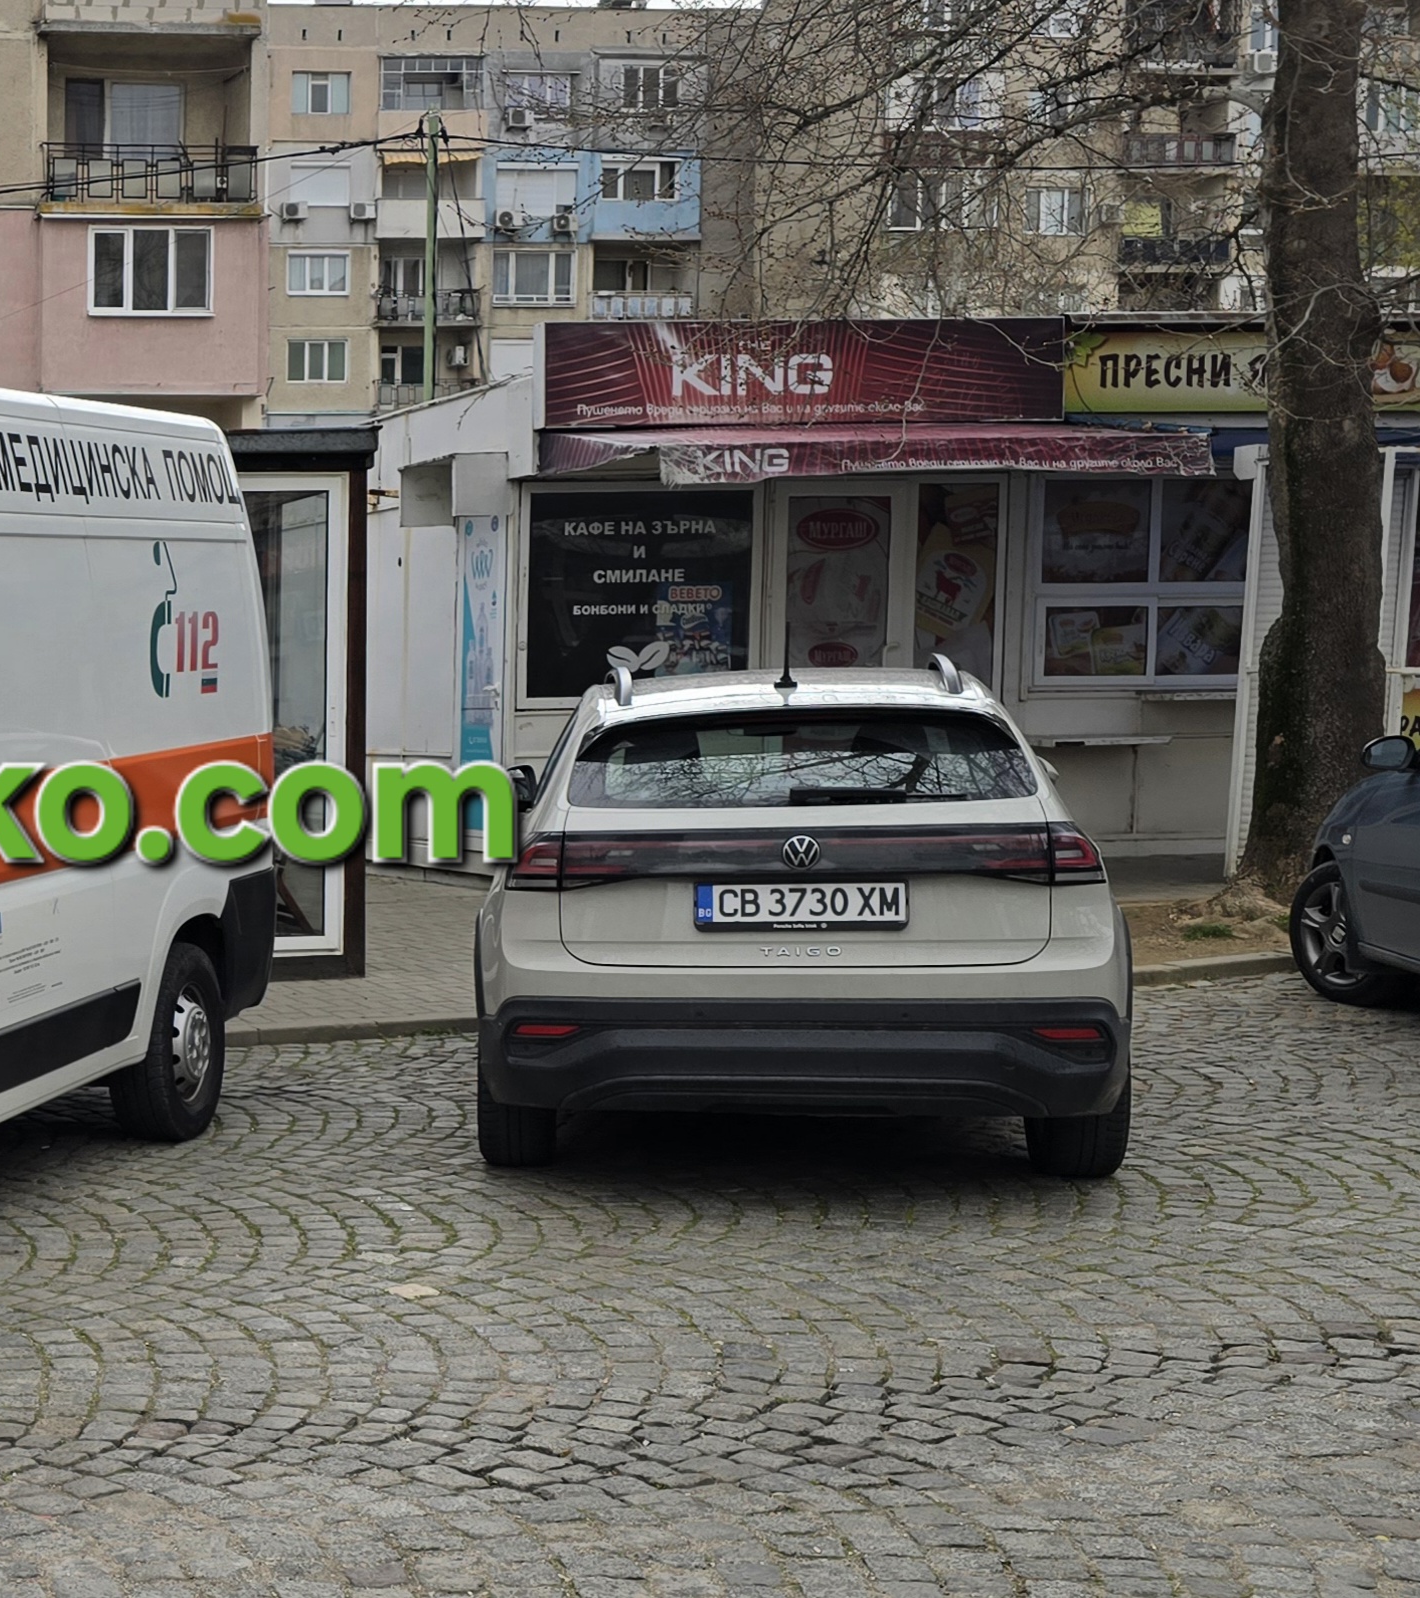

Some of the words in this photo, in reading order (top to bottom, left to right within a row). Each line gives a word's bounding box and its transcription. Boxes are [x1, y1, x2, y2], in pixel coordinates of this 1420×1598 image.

[672, 353, 834, 396] KING
[1098, 353, 1232, 389] ПРЕСНИ
[577, 404, 643, 417] Пушенето
[761, 402, 785, 415] Вас
[697, 448, 790, 474] KING
[1019, 457, 1041, 468] Вас
[1053, 460, 1067, 469] на
[1070, 459, 1119, 471] другите
[1156, 456, 1179, 468] Вас
[564, 521, 615, 536] КАФЕ
[621, 521, 646, 535] НА
[651, 520, 717, 535] ЗЪРНА
[808, 520, 869, 539] МУРГАШ
[633, 545, 646, 559] И
[593, 568, 685, 584] СМИЛАНЕ
[572, 604, 636, 616] БОНБОНИ
[640, 604, 649, 615] И
[175, 611, 220, 673] 112
[718, 888, 761, 918] CB
[768, 887, 849, 918] 3730
[856, 886, 901, 917] XM
[698, 908, 712, 918] BG
[760, 946, 842, 957] TAIGO
